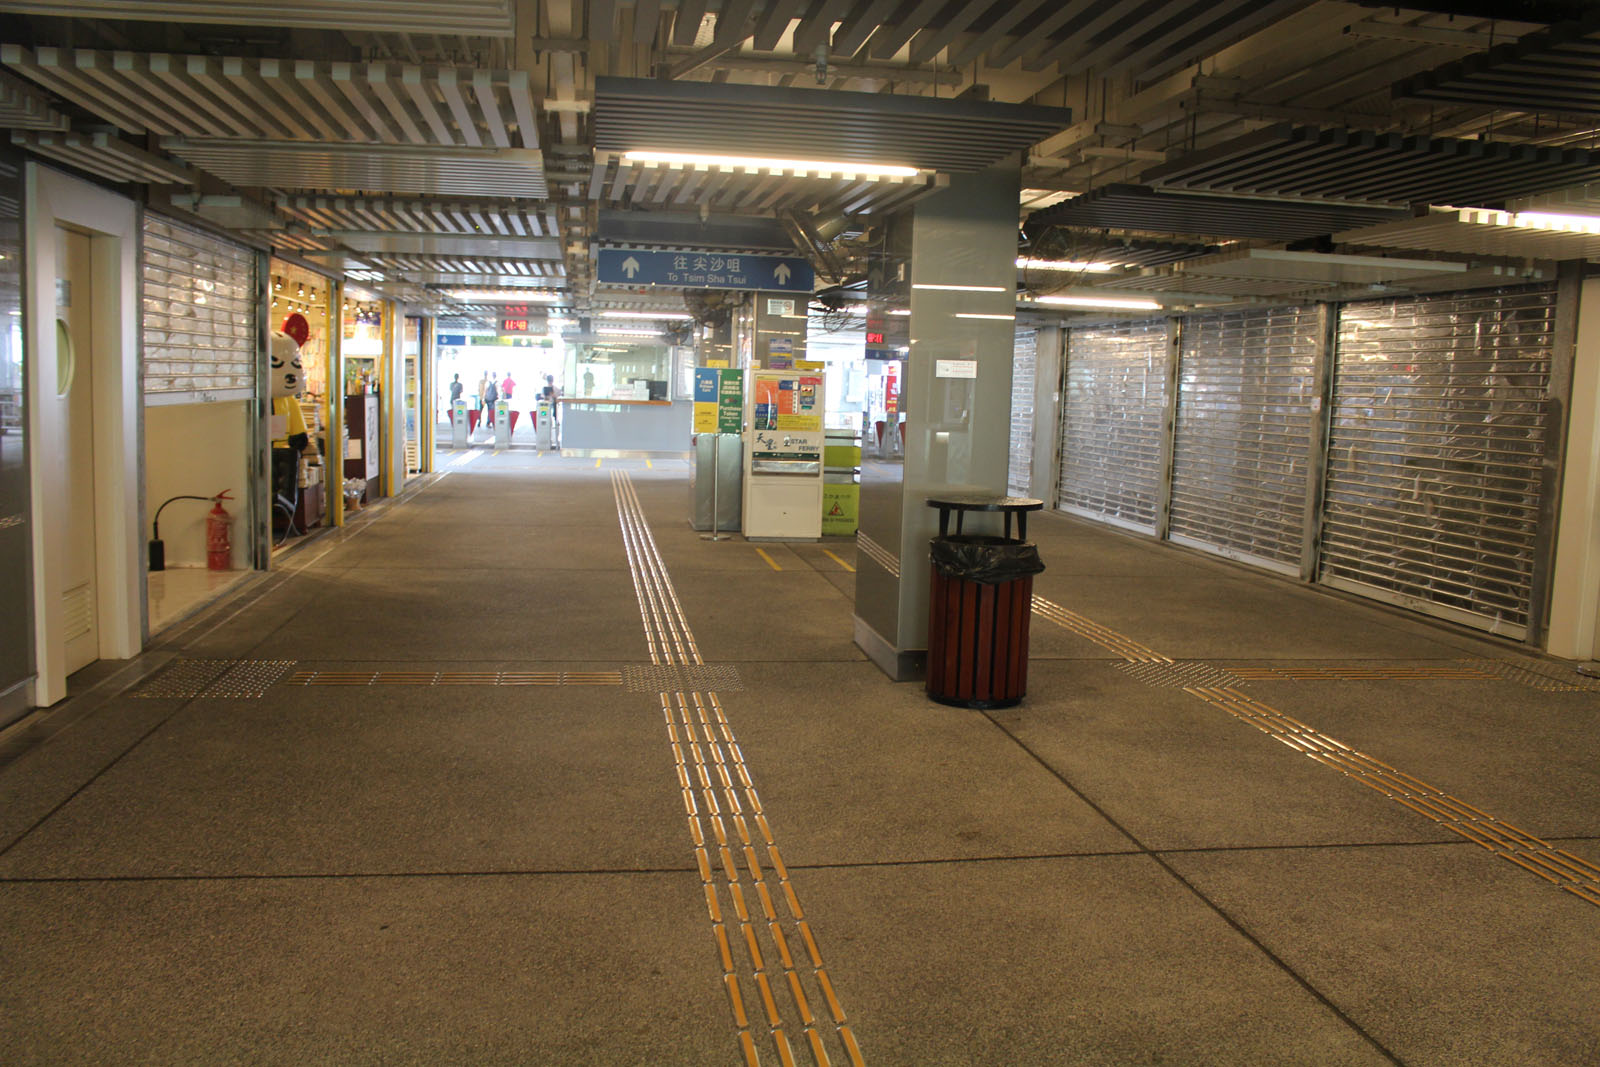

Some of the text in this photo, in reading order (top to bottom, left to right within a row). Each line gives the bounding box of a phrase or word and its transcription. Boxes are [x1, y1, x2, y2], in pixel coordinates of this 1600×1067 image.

[667, 272, 747, 285] To Tsim Sha Tsui
